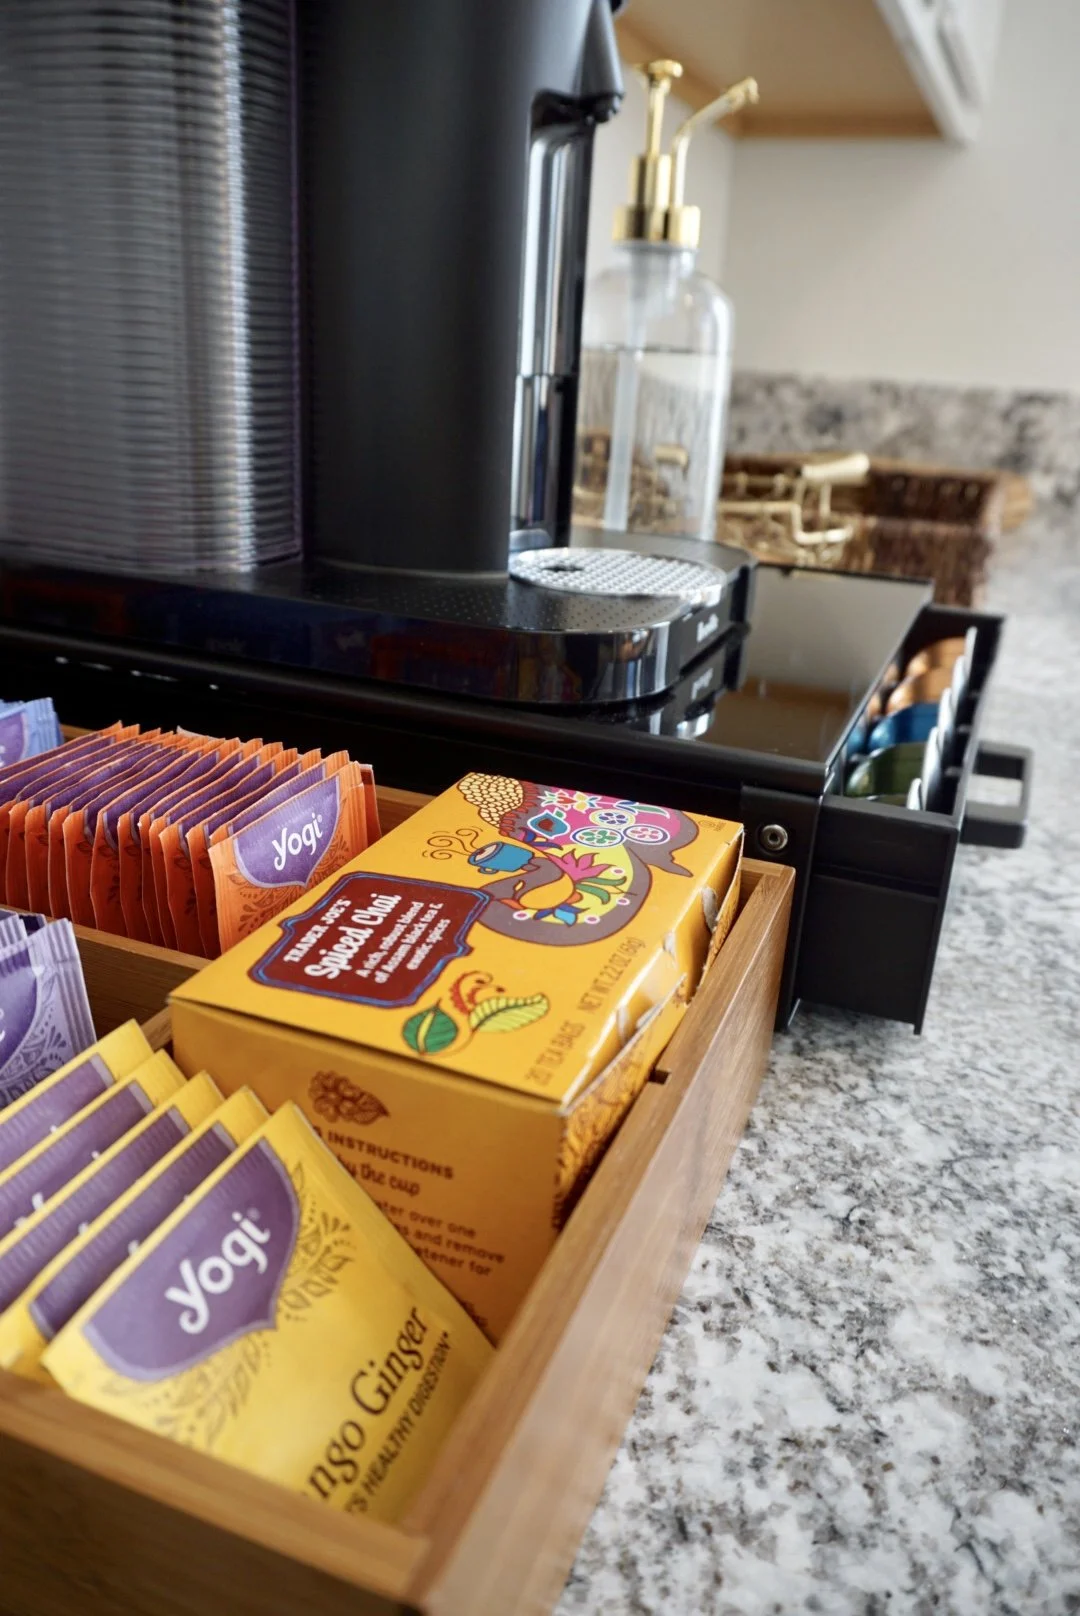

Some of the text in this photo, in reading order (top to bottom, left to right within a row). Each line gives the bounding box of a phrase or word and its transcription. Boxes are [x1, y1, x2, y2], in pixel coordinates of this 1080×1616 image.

[283, 897, 352, 963] TRADER JOE'S
[420, 909, 438, 922] tea
[425, 918, 451, 944] spices
[304, 893, 402, 979] Spiced Chai
[355, 968, 371, 978] A
[379, 923, 408, 950] robust
[396, 901, 424, 924] blend
[400, 922, 429, 944] black
[380, 943, 412, 973] Assam
[374, 970, 391, 984] of
[327, 1129, 455, 1180] INSTRUCTIONS
[361, 1163, 386, 1186] the
[389, 1174, 421, 1197] cup
[409, 1210, 443, 1229] over
[448, 1223, 476, 1239] one
[414, 1229, 443, 1247] and
[446, 1238, 505, 1265] remove
[469, 1259, 492, 1277] for
[308, 1306, 428, 1500] ngo Ginger
[361, 1411, 415, 1496] HEALTHY
